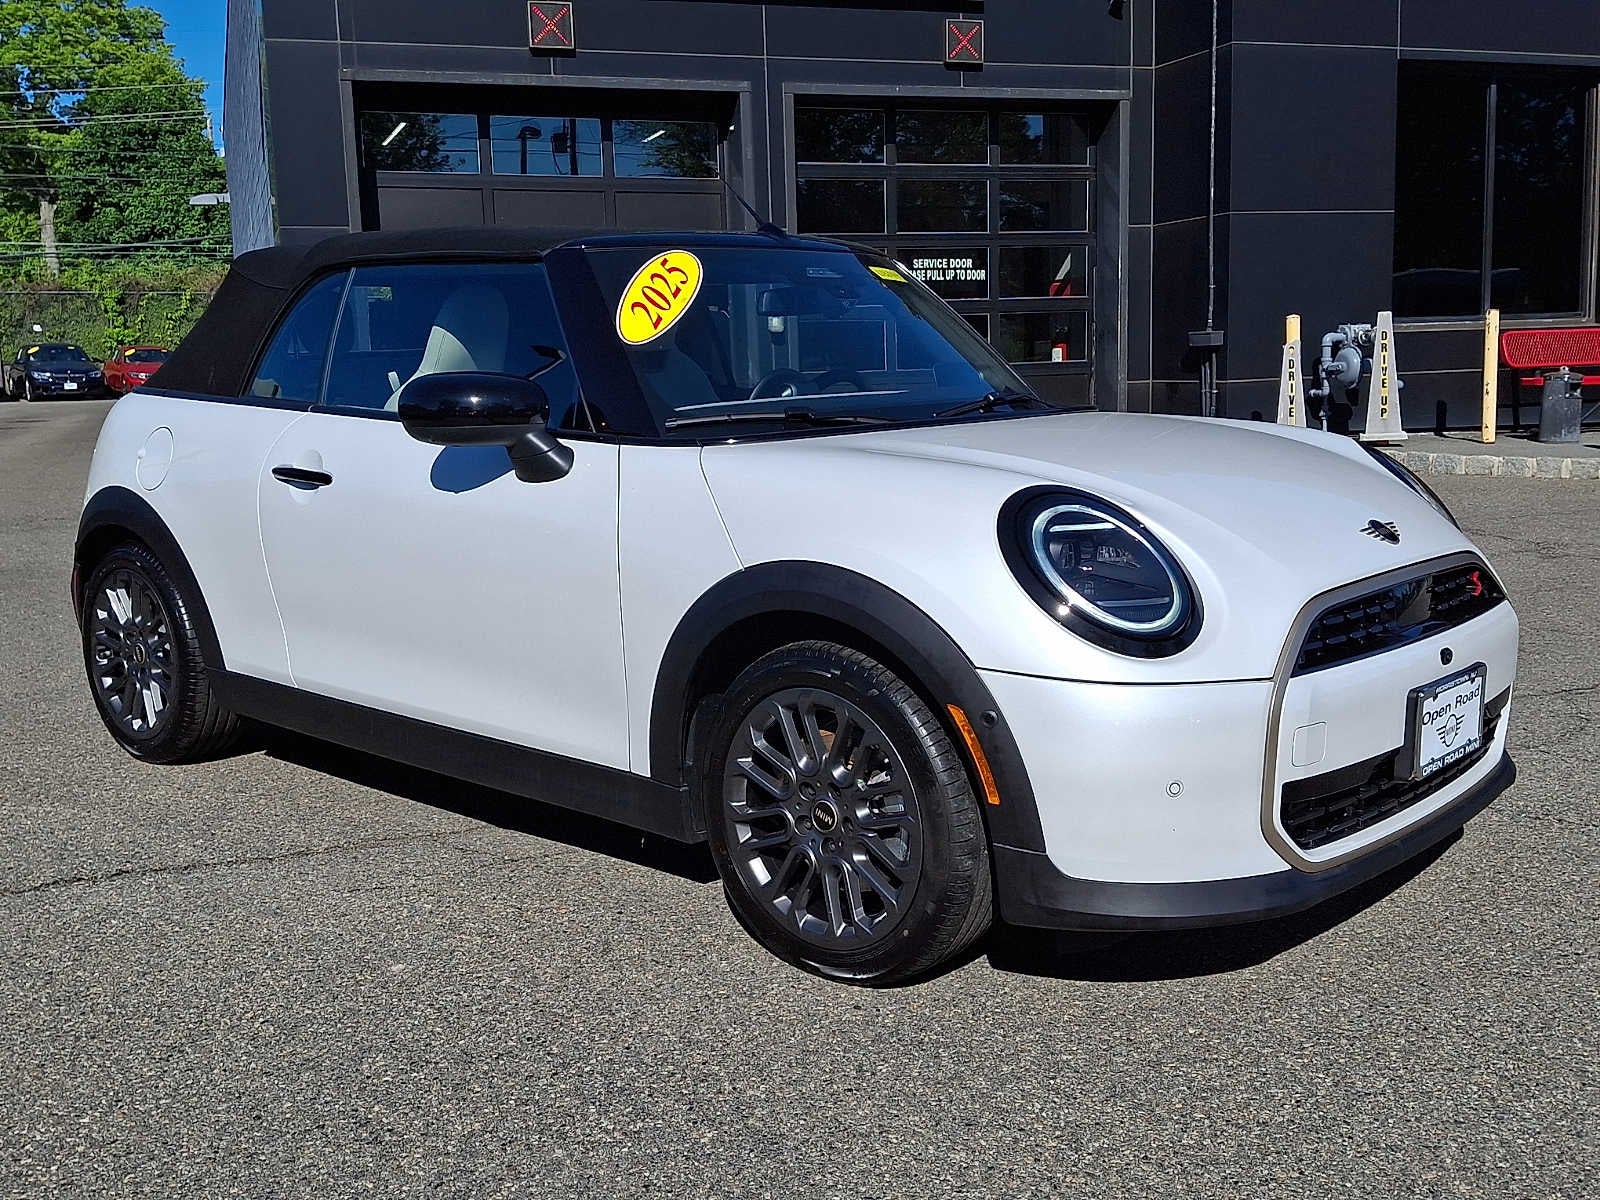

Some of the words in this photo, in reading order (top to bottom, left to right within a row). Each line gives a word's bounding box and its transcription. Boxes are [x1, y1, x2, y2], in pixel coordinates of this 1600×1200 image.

[909, 270, 926, 281] ASE
[926, 270, 945, 281] PULL
[946, 270, 956, 281] UP
[956, 270, 966, 281] TO
[966, 270, 986, 281] DOOR
[913, 258, 948, 269] SERVICE
[949, 258, 973, 269] DOOR
[630, 257, 689, 330] 2025
[1380, 331, 1388, 389] DRIVE
[1422, 703, 1451, 726] Open
[1455, 684, 1480, 709] Road
[1422, 758, 1442, 776] OPEN
[1444, 748, 1464, 766] ROAD
[815, 807, 833, 825] MINI
